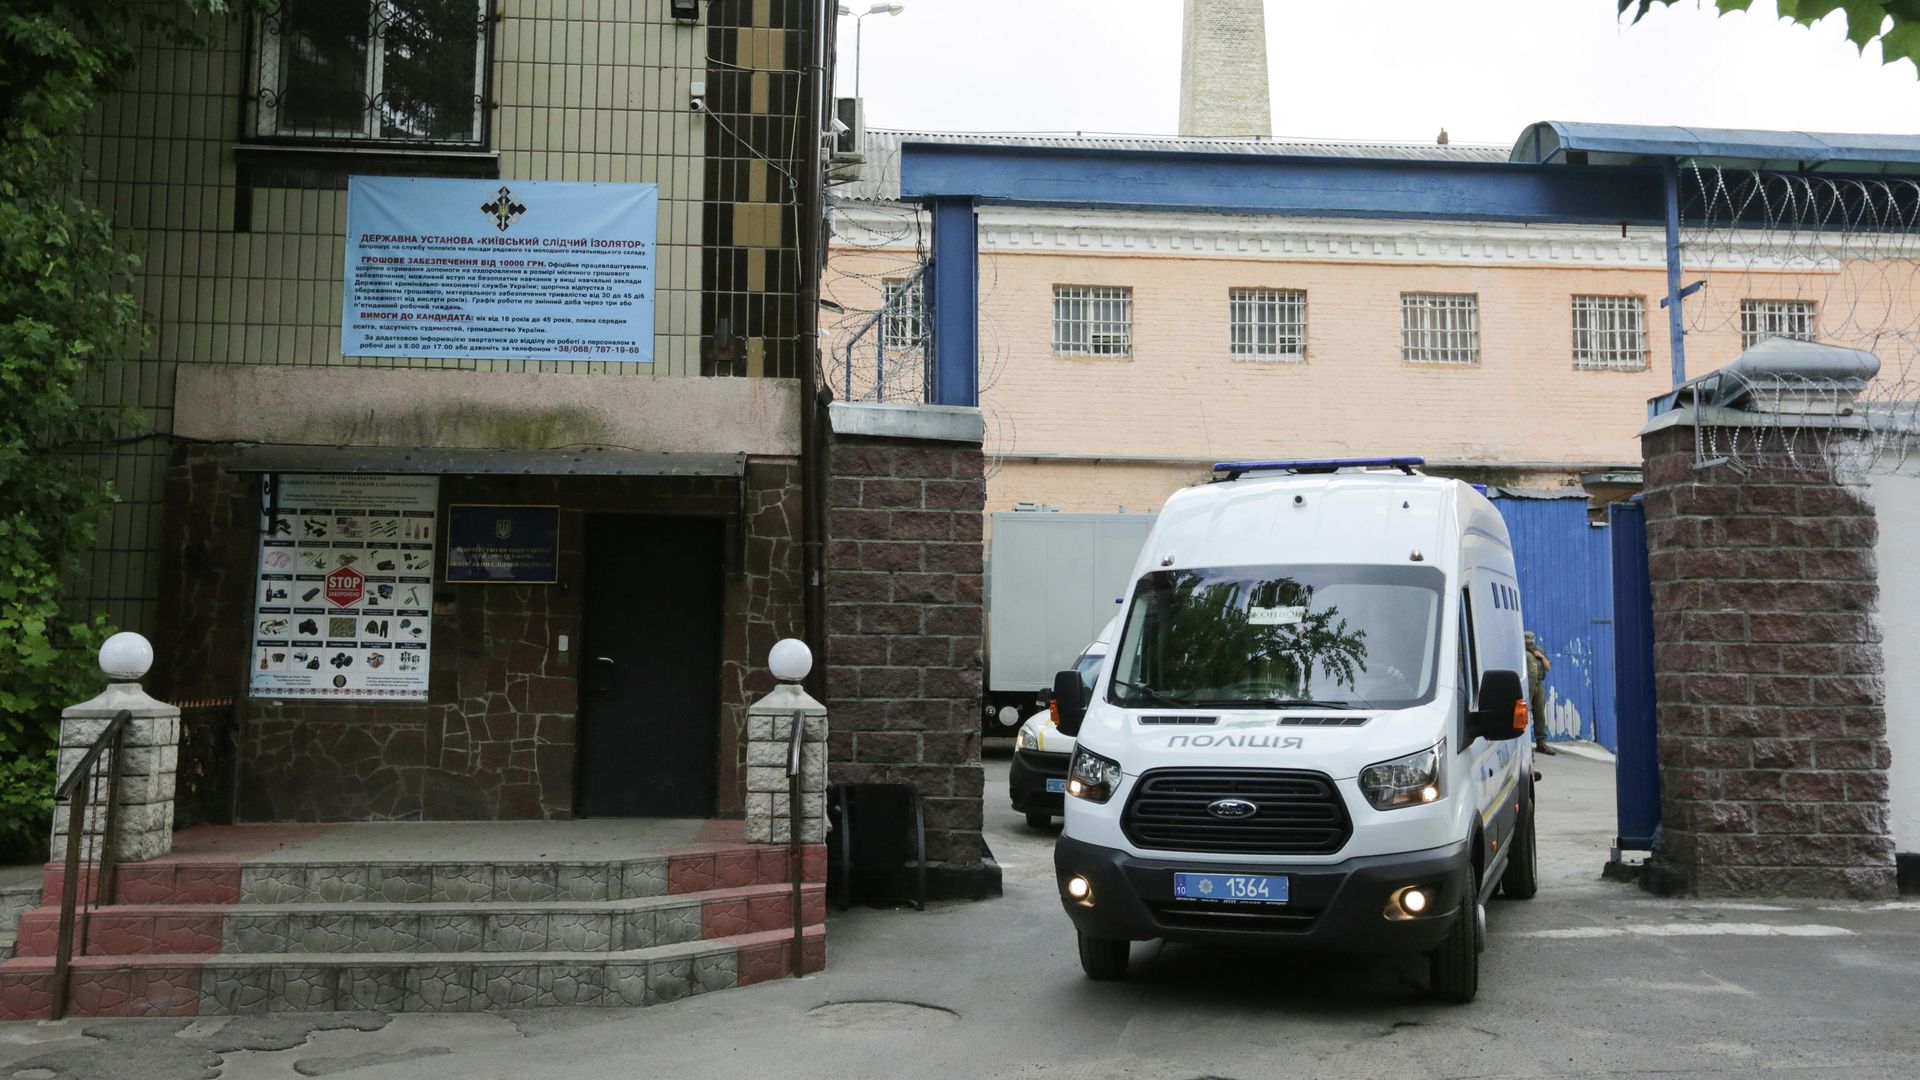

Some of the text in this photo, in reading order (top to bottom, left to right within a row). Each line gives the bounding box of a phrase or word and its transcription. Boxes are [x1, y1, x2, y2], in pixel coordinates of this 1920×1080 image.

[361, 234, 417, 243] ДЕРЖАВНА
[421, 236, 474, 244] УСТАНОВА
[408, 257, 478, 266] ЗАБЕЗПЕЧЕННЯ
[481, 258, 496, 267] ВІД
[360, 312, 398, 320] ВИМОГИ
[416, 314, 474, 322] КАНДИДАТА:
[596, 346, 640, 354] 787-19-68
[329, 576, 360, 588] STOP
[1166, 735, 1304, 750] ПОЛІЦІЯ
[1217, 802, 1244, 815] Ford
[1176, 886, 1186, 895] 10
[1226, 878, 1269, 898] 1364
